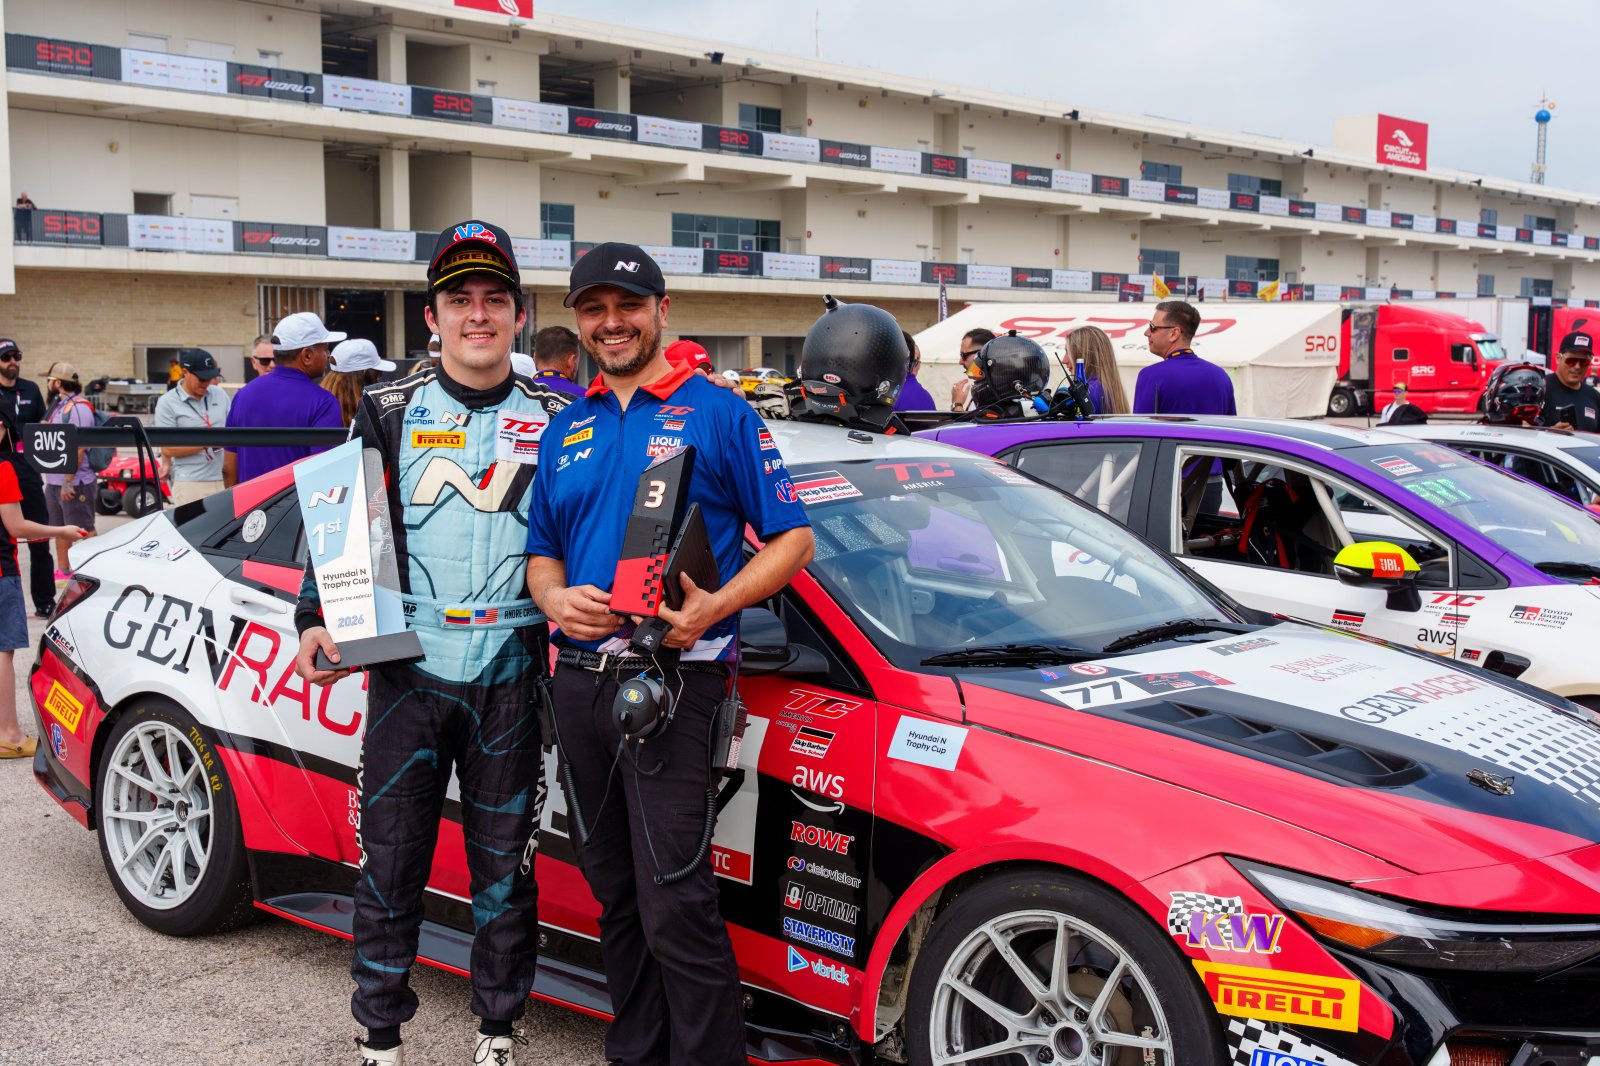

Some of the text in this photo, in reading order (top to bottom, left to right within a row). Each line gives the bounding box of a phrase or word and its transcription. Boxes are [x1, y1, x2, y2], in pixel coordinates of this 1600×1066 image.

[36, 43, 93, 65] SRO
[433, 95, 473, 112] SRO
[720, 130, 749, 145] SRO
[933, 157, 956, 171] SRO
[1101, 178, 1120, 189] SRO
[43, 214, 101, 234] SRO
[455, 224, 485, 240] VP
[719, 254, 749, 267] SRO
[932, 264, 957, 278] SRO
[1305, 336, 1337, 352] SRO
[381, 394, 405, 405] OMP
[548, 401, 565, 410] OM
[502, 417, 546, 433] TC
[34, 431, 66, 451] aws
[417, 434, 461, 445] PIRELLI
[564, 429, 590, 445] PIRELLI
[651, 436, 681, 447] LIQUI
[874, 462, 956, 481] TC
[797, 484, 854, 497] Skip Barber
[902, 480, 945, 491] AMERICA
[643, 480, 666, 508] 3
[804, 490, 860, 503] Racing School
[312, 517, 342, 556] 1st
[1380, 558, 1401, 571] JBL
[322, 569, 358, 581] Hyundai
[322, 577, 370, 589] Trophy Cup
[1430, 592, 1485, 607] TC
[403, 603, 417, 614] MP
[504, 609, 523, 620] ANDRE
[1510, 609, 1538, 621] GR
[1543, 608, 1573, 616] TOYOTA
[337, 613, 365, 628] 2026
[1538, 617, 1566, 625] Racing
[47, 624, 75, 653] RICCA
[1417, 628, 1456, 646] aws
[103, 584, 369, 736] GENRAC
[1060, 680, 1123, 705] 77
[49, 687, 80, 726] PIRELLI
[784, 688, 863, 719] TC
[779, 711, 813, 723] AMERICA
[190, 726, 205, 754] 7706
[793, 739, 827, 752] Skip Barber
[908, 730, 948, 745] Hyundai N
[790, 745, 825, 757] Racing School
[906, 739, 947, 755] Trophy Cup
[792, 765, 845, 798] aws
[790, 821, 851, 855] ROWE
[713, 850, 731, 871] TC
[806, 862, 861, 888] cielovision
[804, 891, 858, 925] OPTIMA
[784, 917, 856, 951] STAY FROSTY
[1187, 911, 1287, 954] KW
[789, 932, 854, 957] PERFORMANCE COOLANTS
[811, 959, 850, 985] vbrick
[1204, 971, 1346, 1020] PIRELLI
